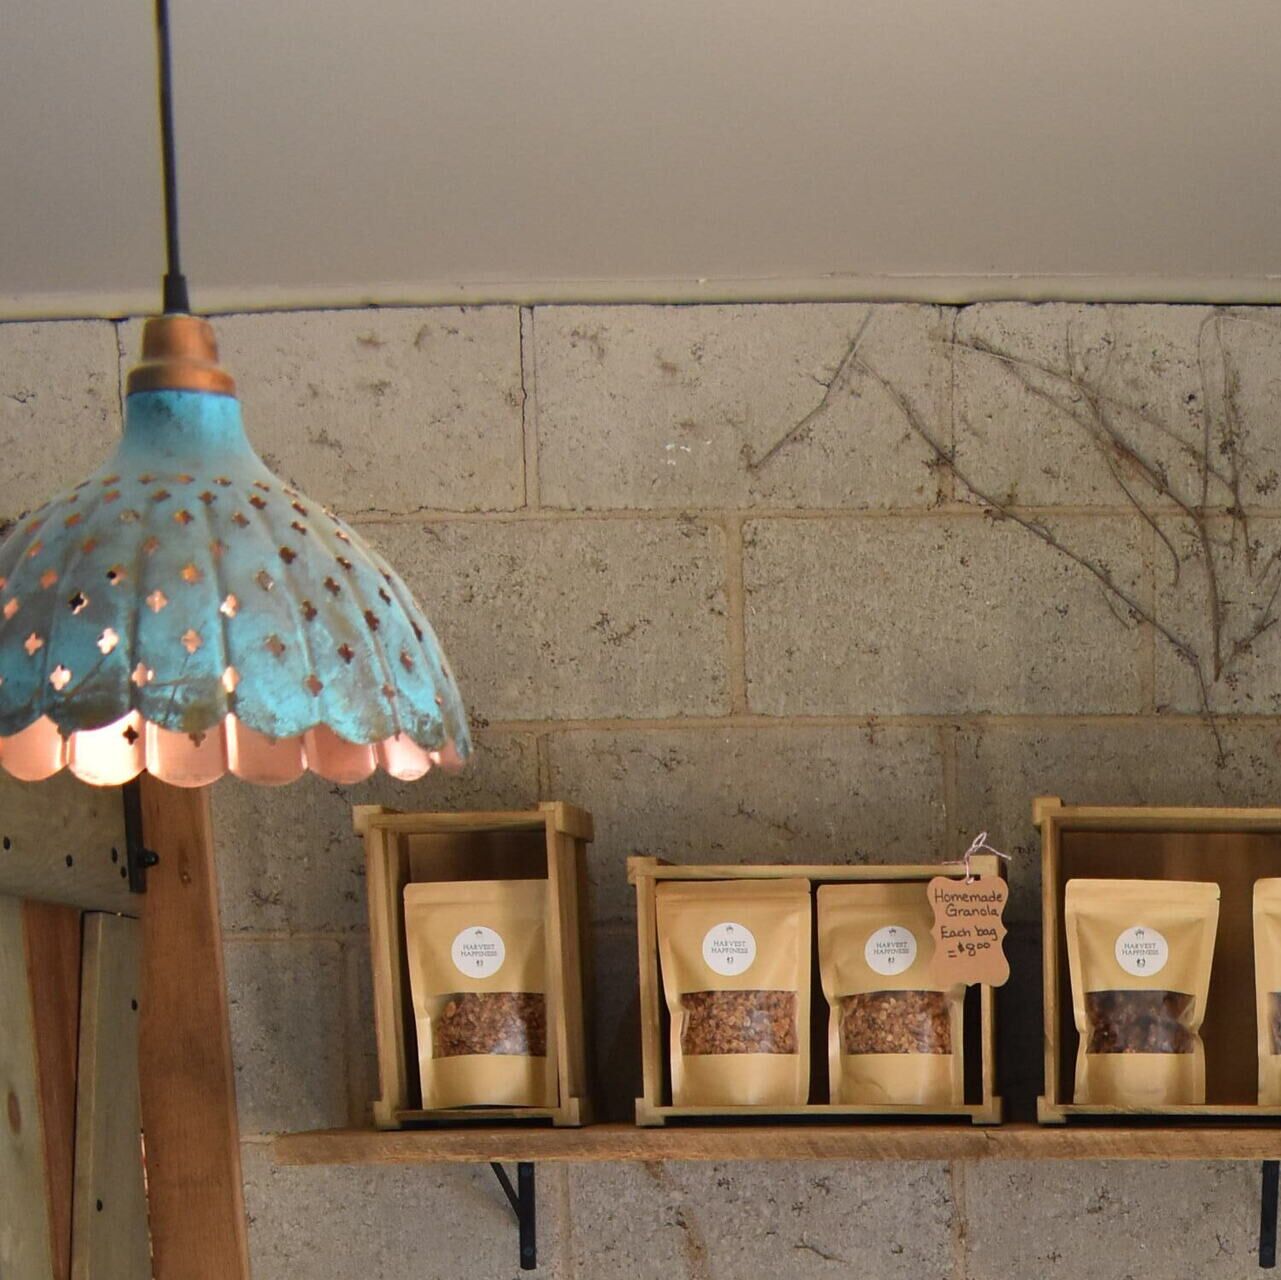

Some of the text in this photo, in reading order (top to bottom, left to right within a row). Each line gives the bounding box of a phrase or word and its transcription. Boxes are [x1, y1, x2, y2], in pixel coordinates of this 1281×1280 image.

[934, 887, 1002, 904] Homemade
[945, 903, 999, 917] Granola
[940, 925, 998, 941] Each bag
